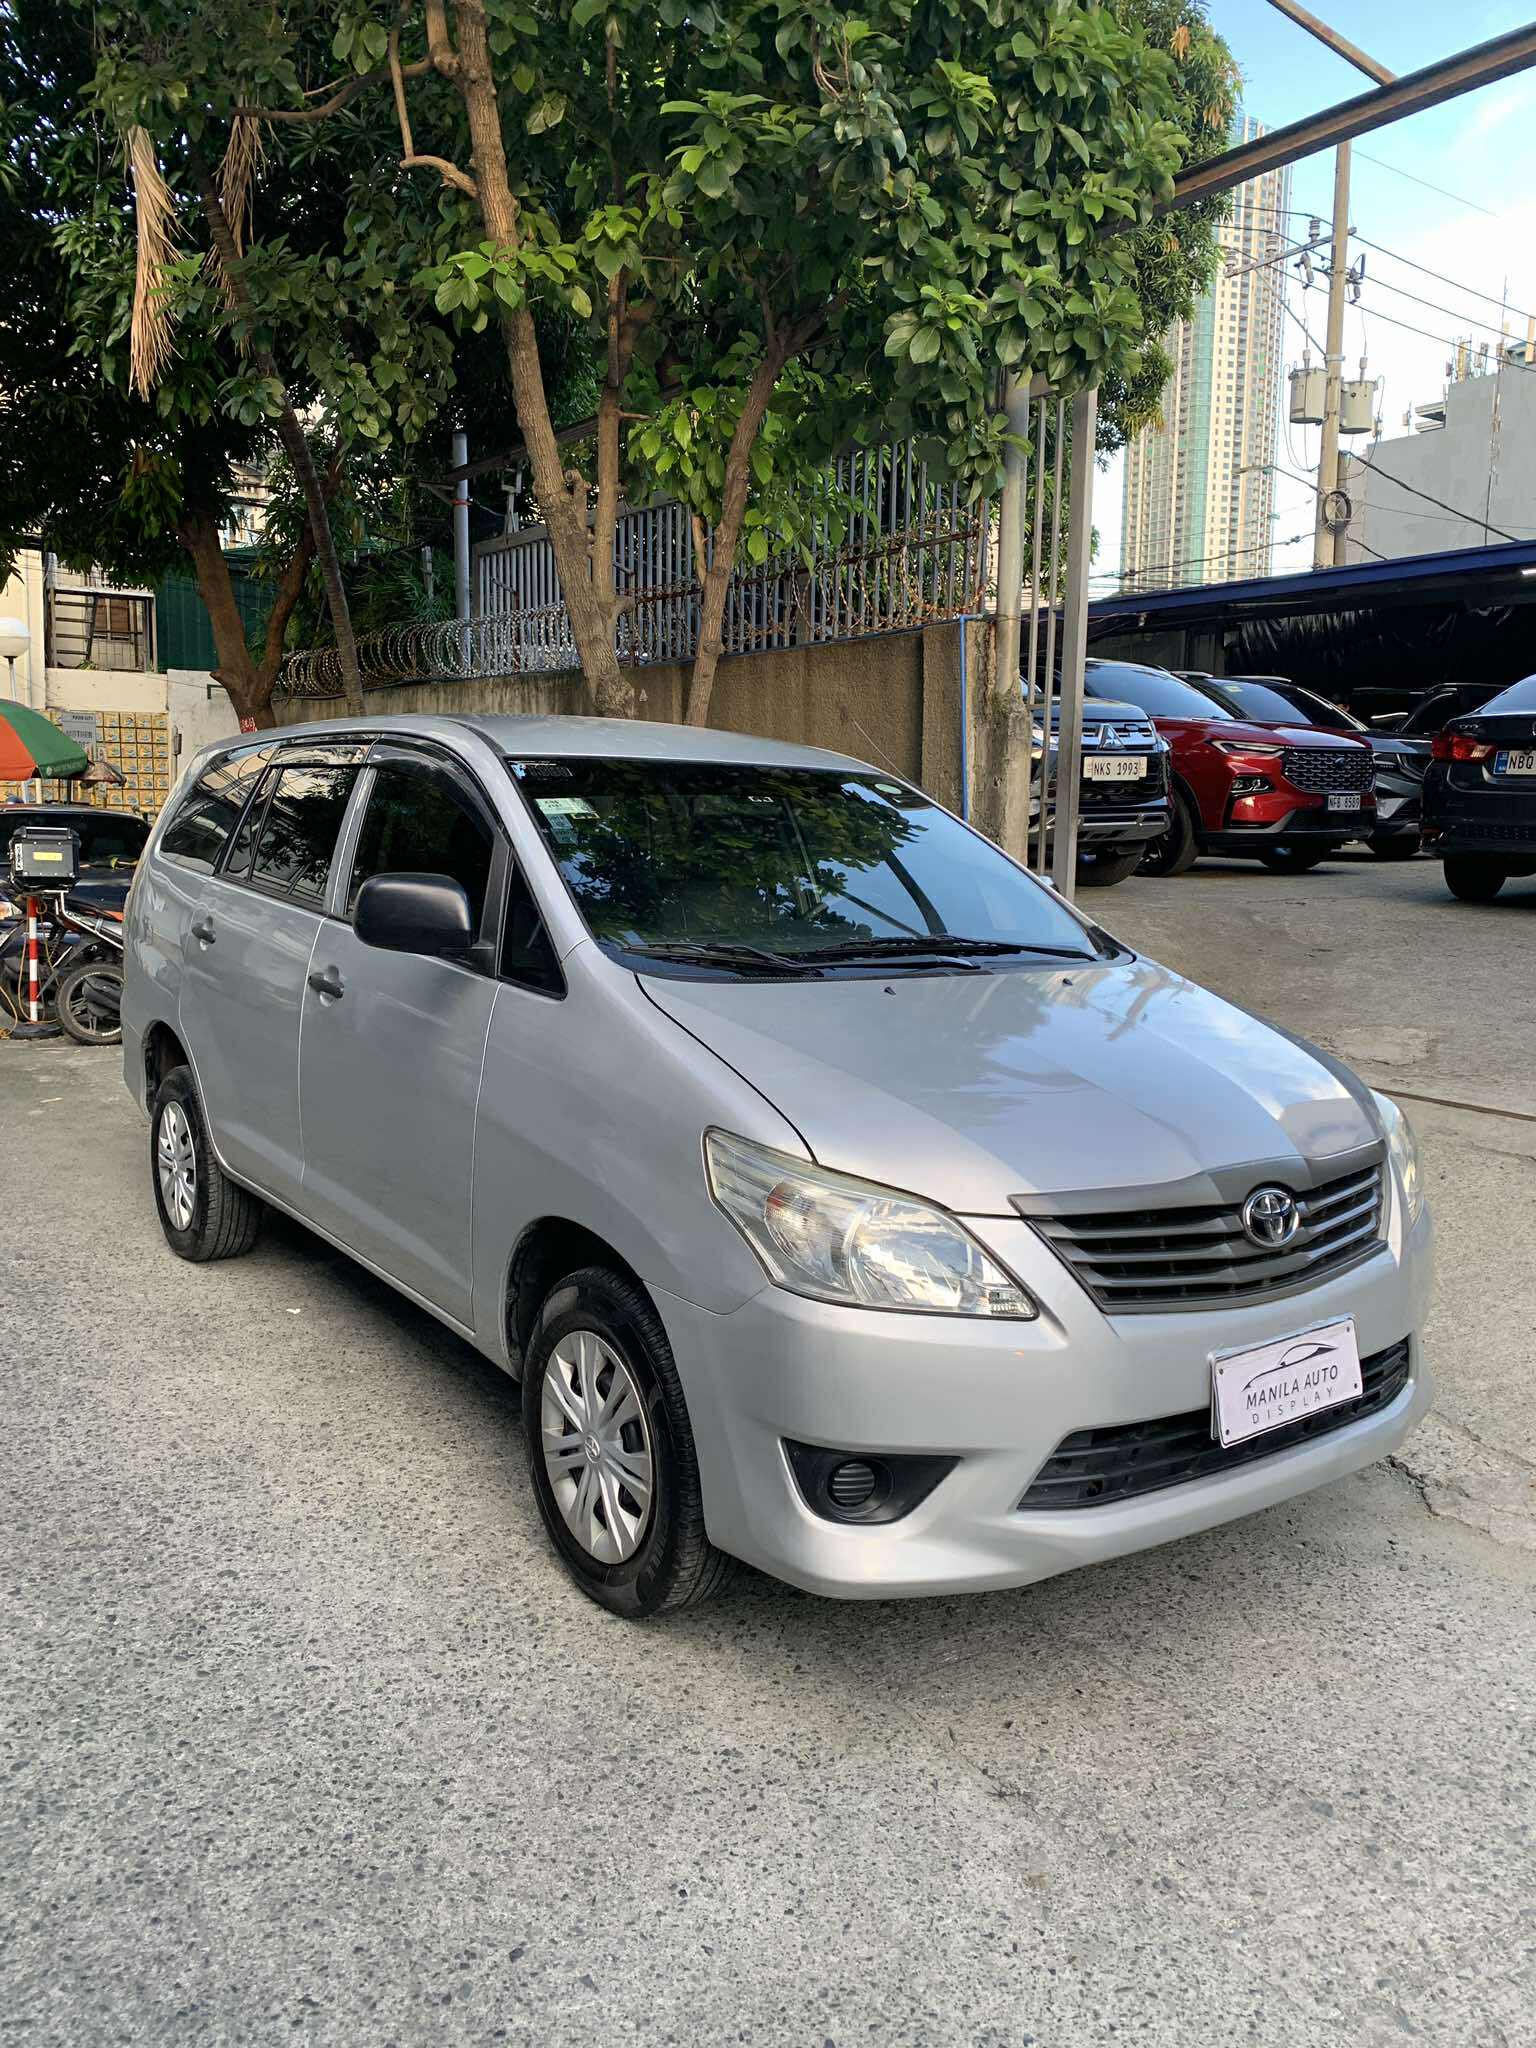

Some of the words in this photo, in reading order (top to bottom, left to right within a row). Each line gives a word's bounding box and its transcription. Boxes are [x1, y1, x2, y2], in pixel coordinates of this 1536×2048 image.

[1093, 762, 1111, 776] NKS
[1116, 762, 1139, 776] 1993
[1508, 755, 1534, 770] NBQ
[1246, 1379, 1300, 1410] MANILA
[1304, 1364, 1339, 1390] AUTO
[1252, 1386, 1337, 1425] DISPLAY
